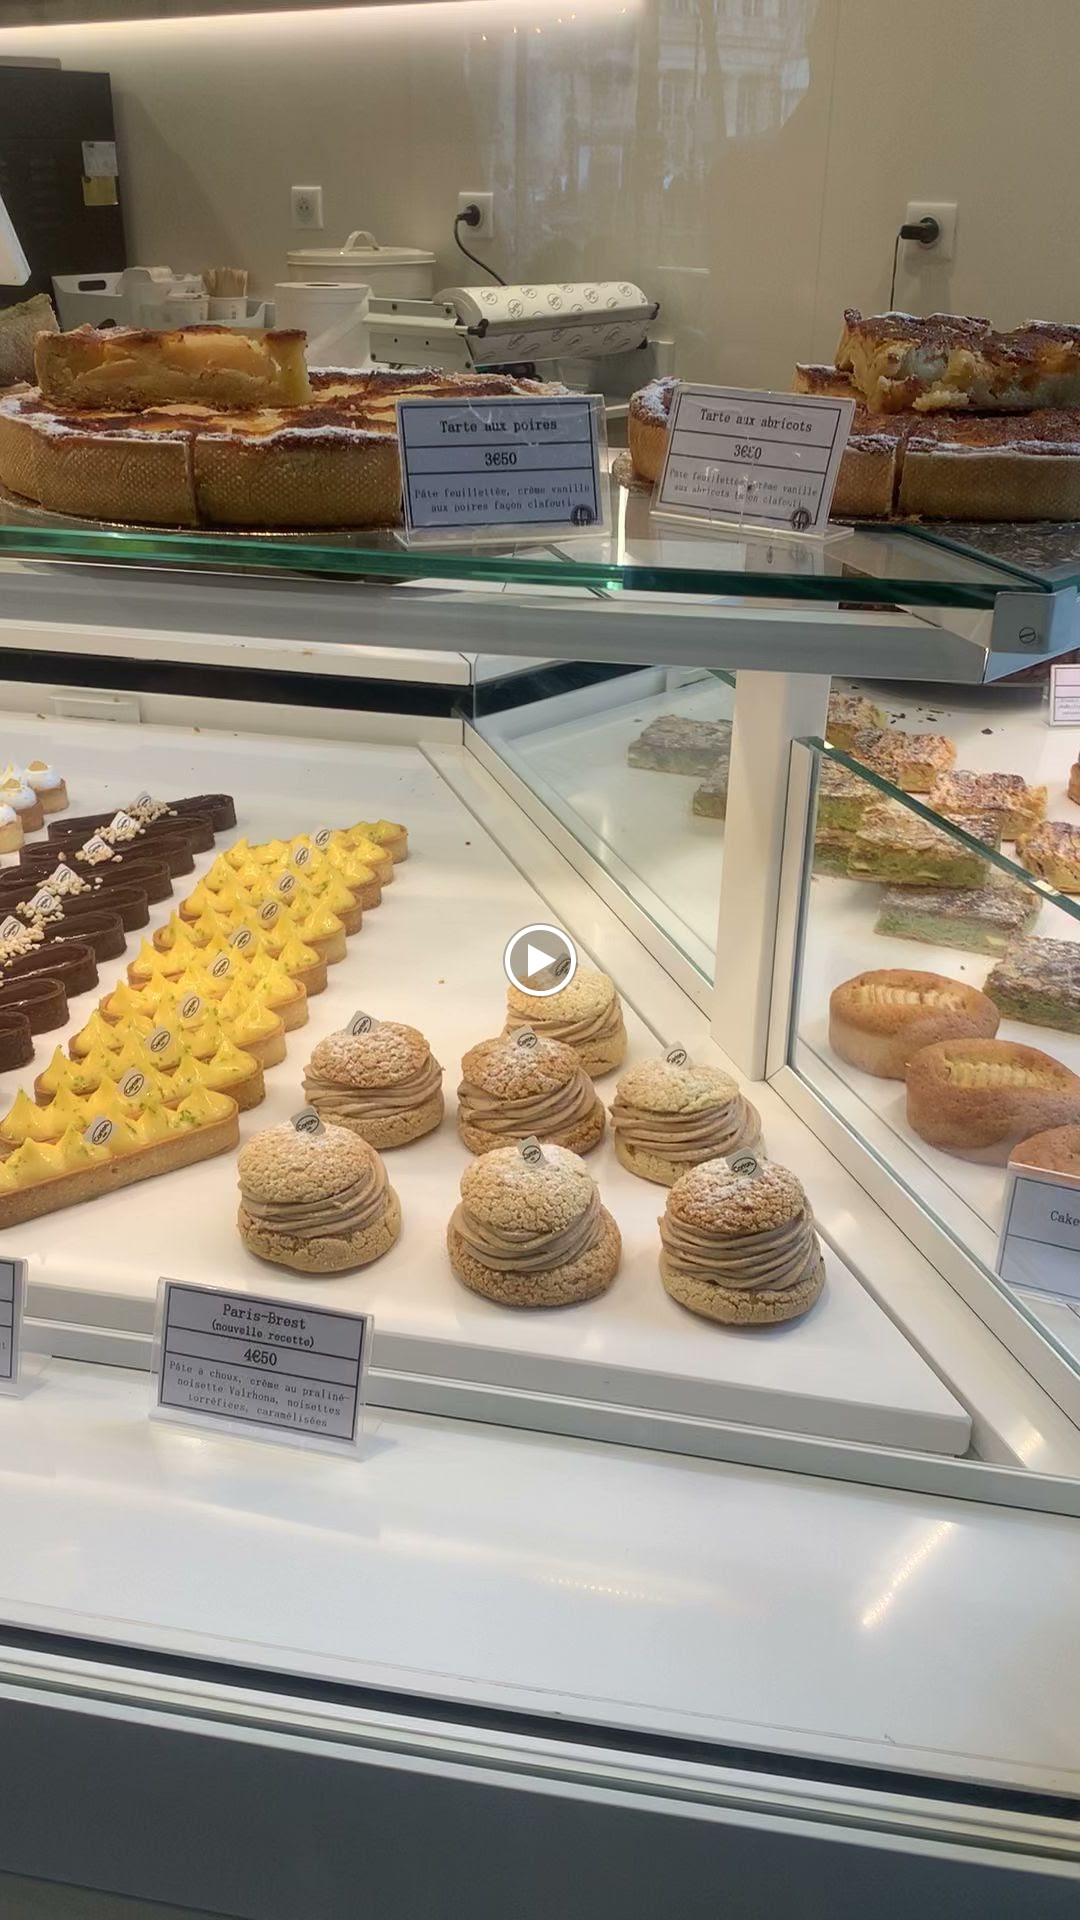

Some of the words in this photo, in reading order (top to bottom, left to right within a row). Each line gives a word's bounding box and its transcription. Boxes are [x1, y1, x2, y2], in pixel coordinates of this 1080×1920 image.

[439, 420, 478, 433] Tarte
[484, 421, 508, 432] aux
[512, 417, 558, 433] poires
[700, 407, 731, 423] Tarte
[735, 415, 756, 425] aux
[760, 415, 813, 432] abricots
[484, 451, 518, 466] 3€50
[551, 482, 590, 493] vanille
[431, 504, 449, 512] aux
[454, 503, 489, 512] poires
[494, 500, 522, 511] façon
[222, 1303, 306, 1329] Paris-Brest
[211, 1318, 263, 1338] (nouvelle
[267, 1331, 315, 1348] recette)
[243, 1348, 278, 1366] 4€50
[169, 1360, 193, 1373] Pâte
[209, 1368, 242, 1383] choux,
[249, 1376, 280, 1390] crème
[284, 1384, 297, 1393] au
[177, 1377, 224, 1392] noisette
[287, 1398, 341, 1415] noisettes
